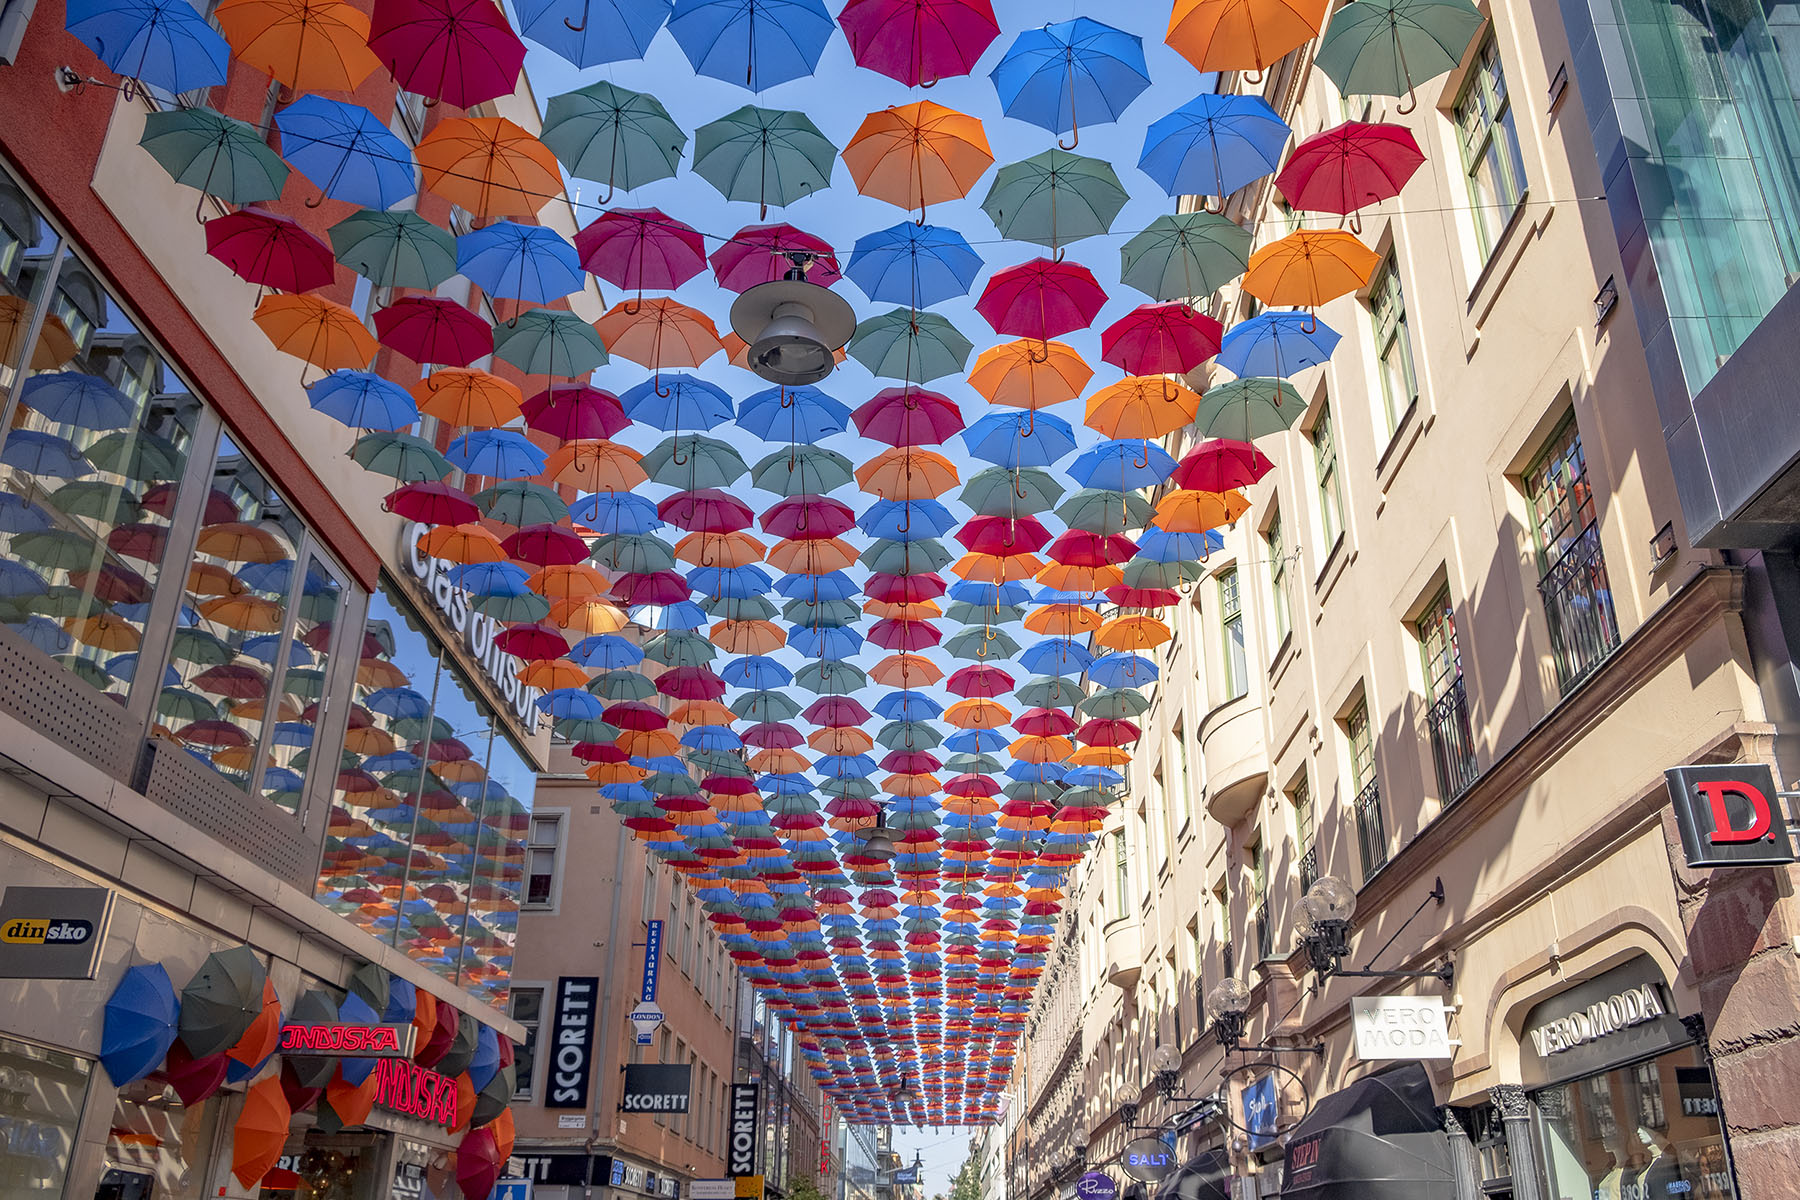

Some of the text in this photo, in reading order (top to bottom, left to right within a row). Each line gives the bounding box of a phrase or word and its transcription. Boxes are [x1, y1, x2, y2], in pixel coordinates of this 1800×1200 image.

[644, 921, 658, 1001] RESTAURANG
[632, 1013, 661, 1021] LONDON
[1363, 1007, 1435, 1025] VERO
[1529, 983, 1664, 1057] VERO MODA
[282, 1025, 399, 1051] INDISKA
[553, 981, 591, 1102] SCORETT
[1363, 1029, 1444, 1047] MODA
[624, 1094, 688, 1110] SCORETT
[732, 1087, 754, 1173] SCORETT
[1129, 1154, 1169, 1165] SALT
